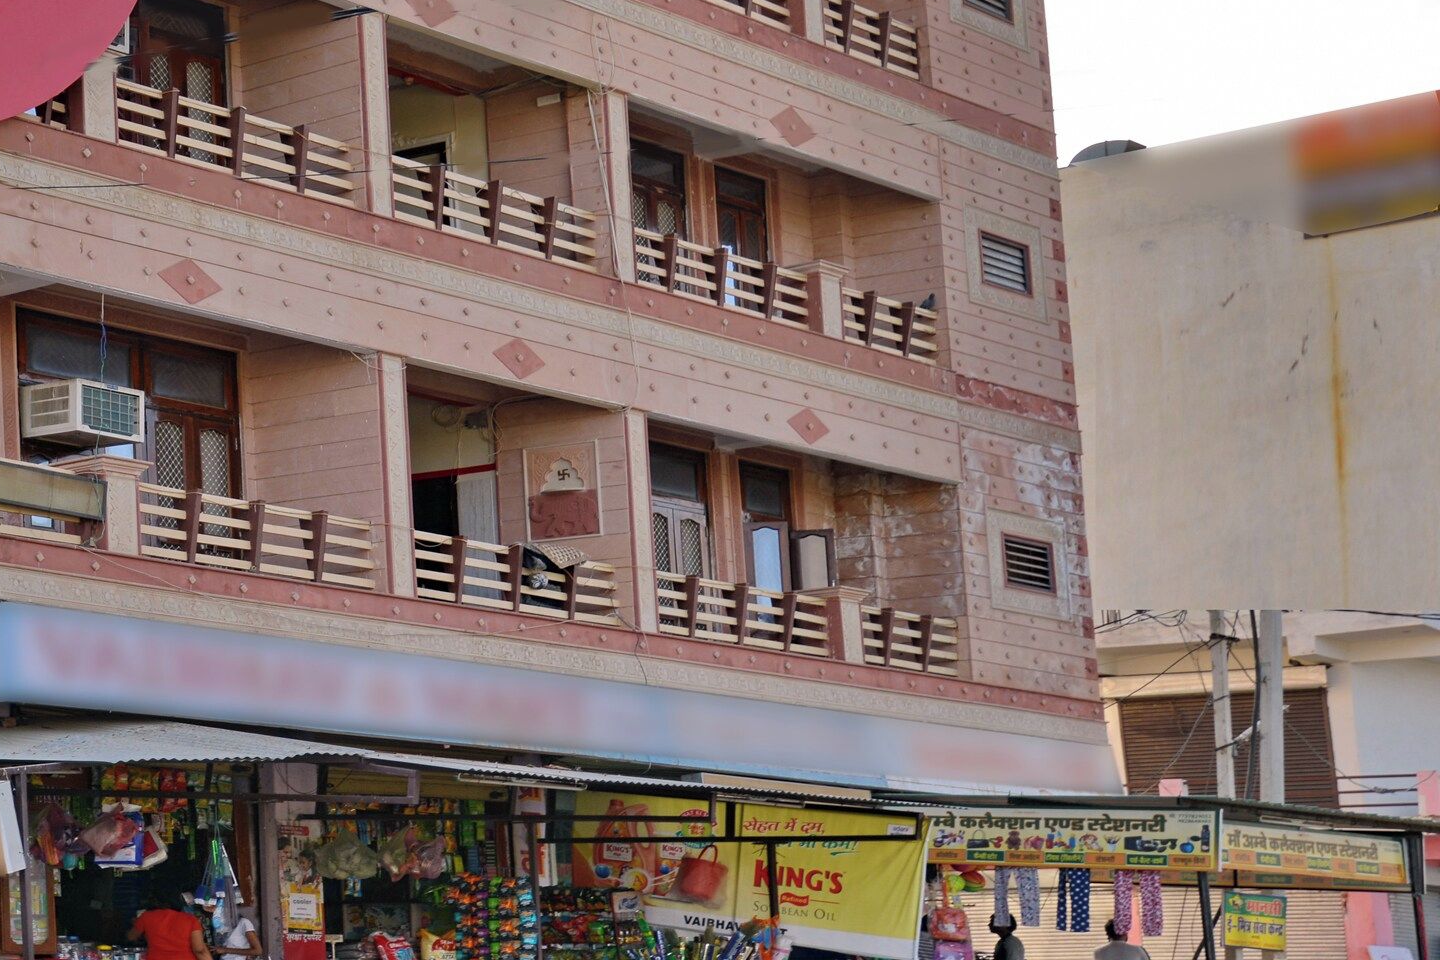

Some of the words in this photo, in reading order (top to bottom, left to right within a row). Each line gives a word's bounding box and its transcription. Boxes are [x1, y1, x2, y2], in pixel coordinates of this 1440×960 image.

[743, 817, 779, 834] सेहत
[783, 817, 798, 832] में
[753, 859, 844, 895] KING'S
[753, 900, 809, 918] SOBEAN
